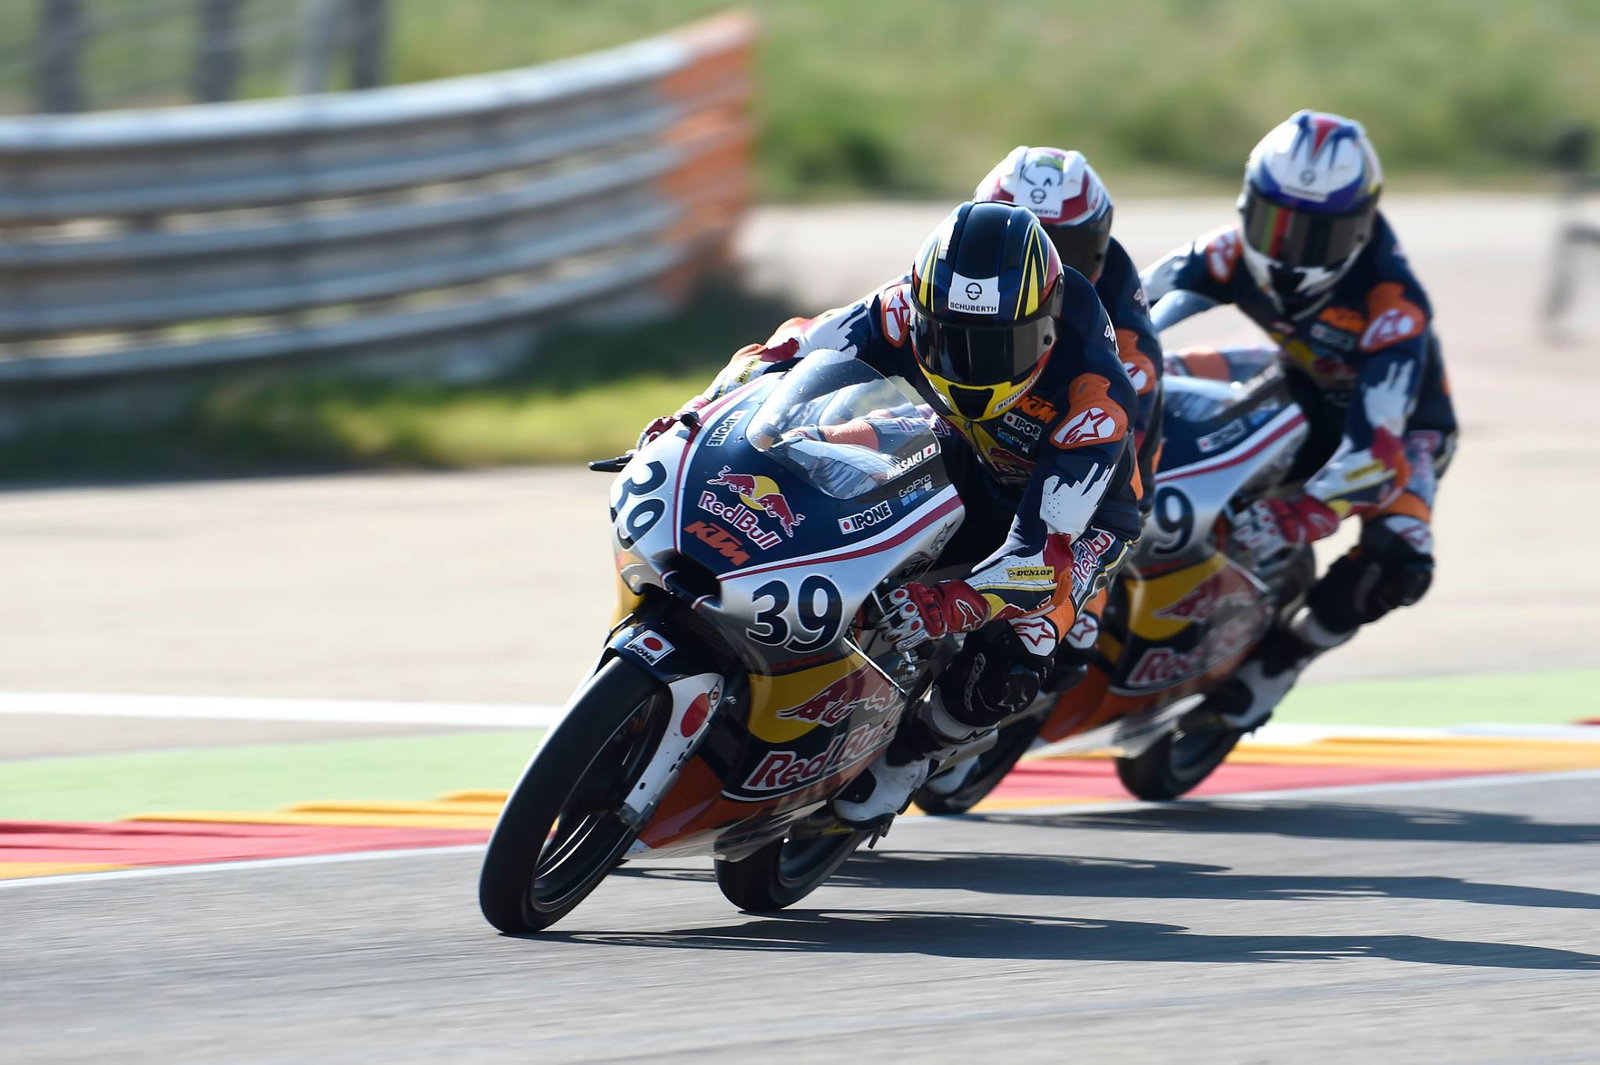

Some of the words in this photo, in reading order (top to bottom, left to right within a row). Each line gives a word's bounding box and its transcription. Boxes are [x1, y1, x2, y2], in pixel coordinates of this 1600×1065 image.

[949, 301, 997, 313] SCHUBERTH
[708, 418, 739, 446] IPONE
[898, 474, 932, 498] GoPro
[610, 460, 667, 549] 39
[850, 502, 891, 530] IPONE
[683, 520, 751, 566] KTM
[1016, 569, 1053, 577] DUNLOP
[746, 574, 843, 653] 39
[627, 643, 657, 664] IPONE
